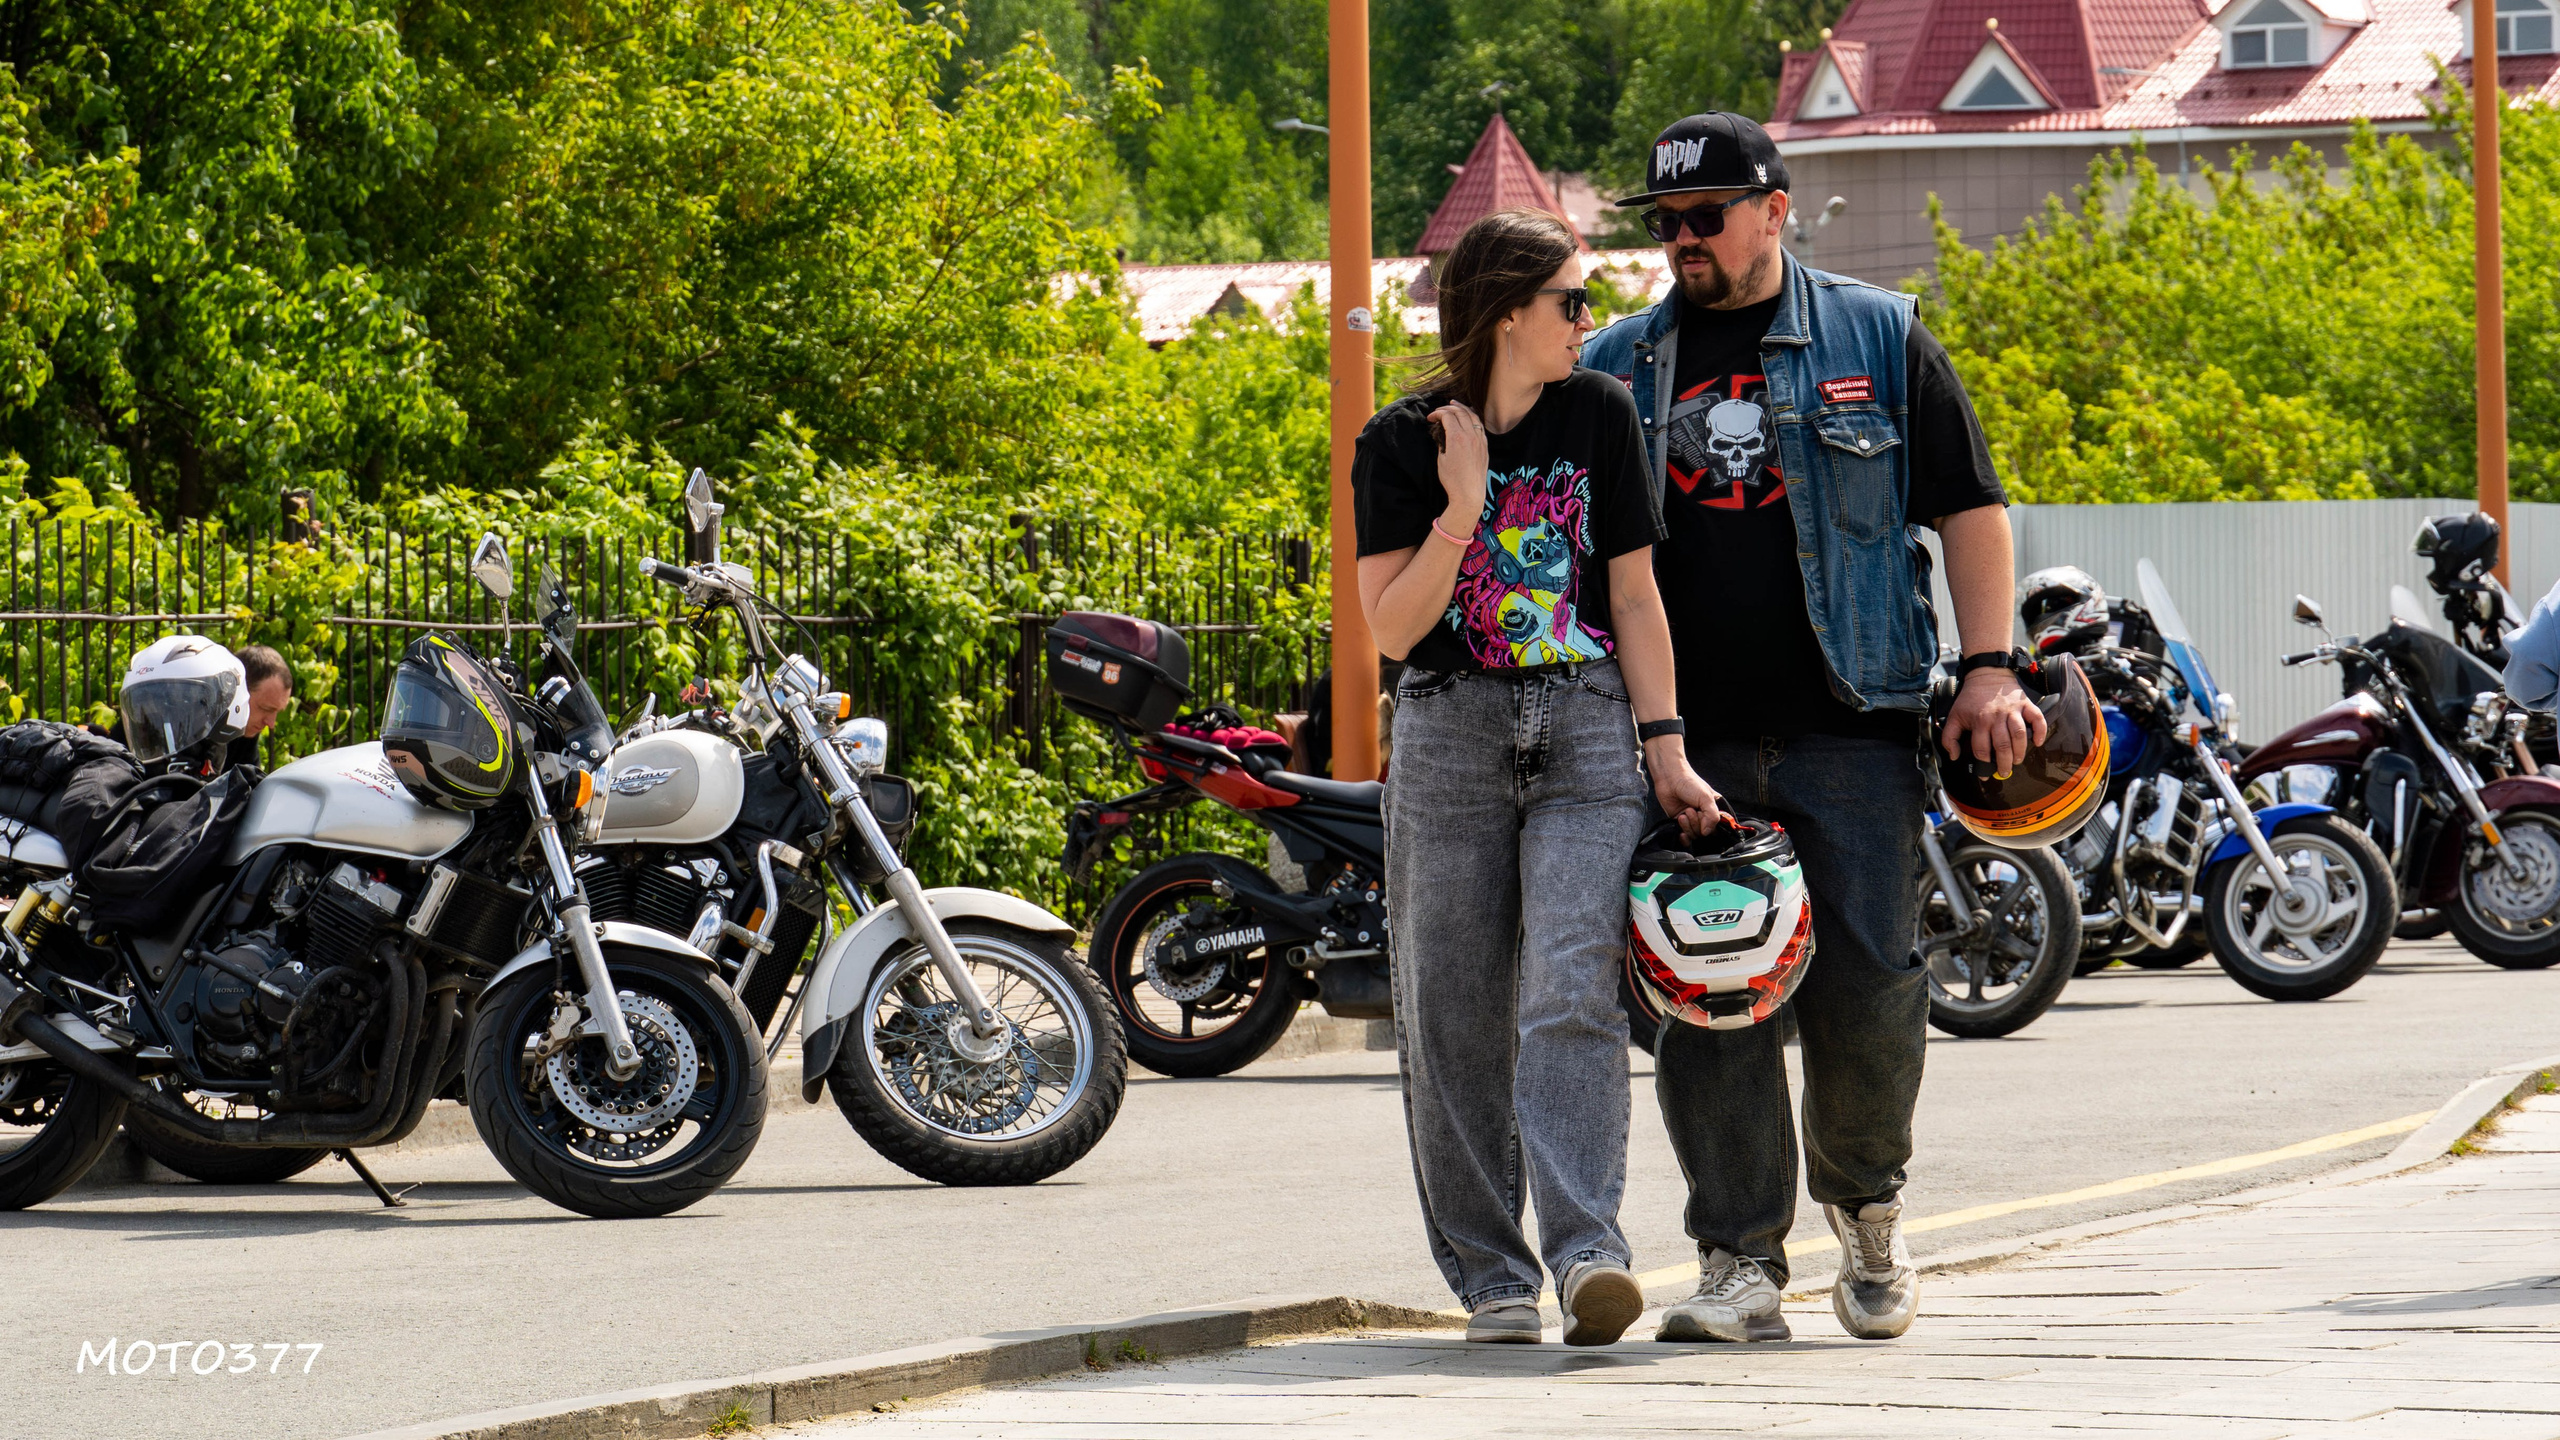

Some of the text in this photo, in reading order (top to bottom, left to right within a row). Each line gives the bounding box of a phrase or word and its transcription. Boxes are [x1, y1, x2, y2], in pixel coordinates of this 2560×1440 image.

[354, 767, 396, 791] HONDA
[611, 771, 669, 783] hadow
[1209, 926, 1266, 951] YAMAHA
